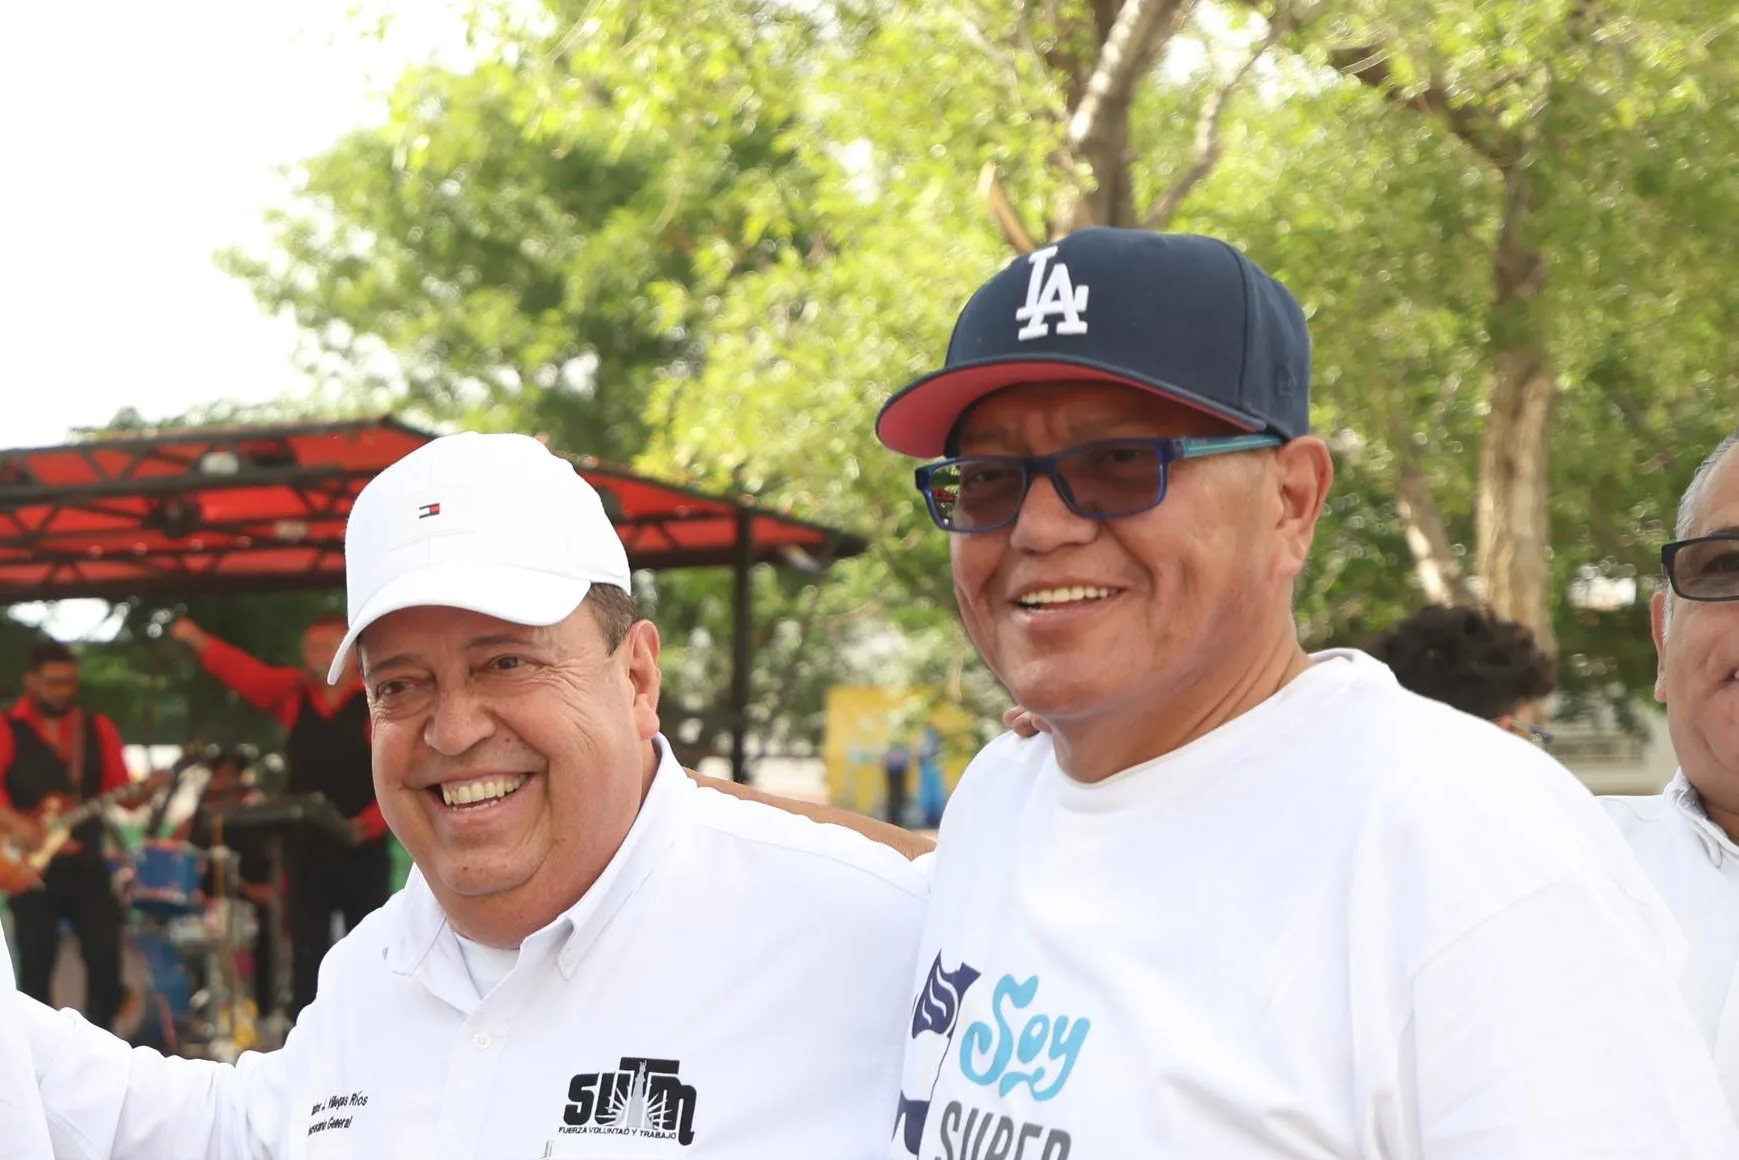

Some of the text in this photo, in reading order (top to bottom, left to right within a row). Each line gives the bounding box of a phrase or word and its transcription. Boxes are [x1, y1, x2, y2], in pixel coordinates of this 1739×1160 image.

[1016, 245, 1089, 341] LA
[959, 973, 1091, 1101] Soy
[349, 1090, 368, 1107] Ríos
[327, 1115, 353, 1130] General
[558, 1126, 587, 1134] FUERZA
[639, 1130, 677, 1140] TRABAJO
